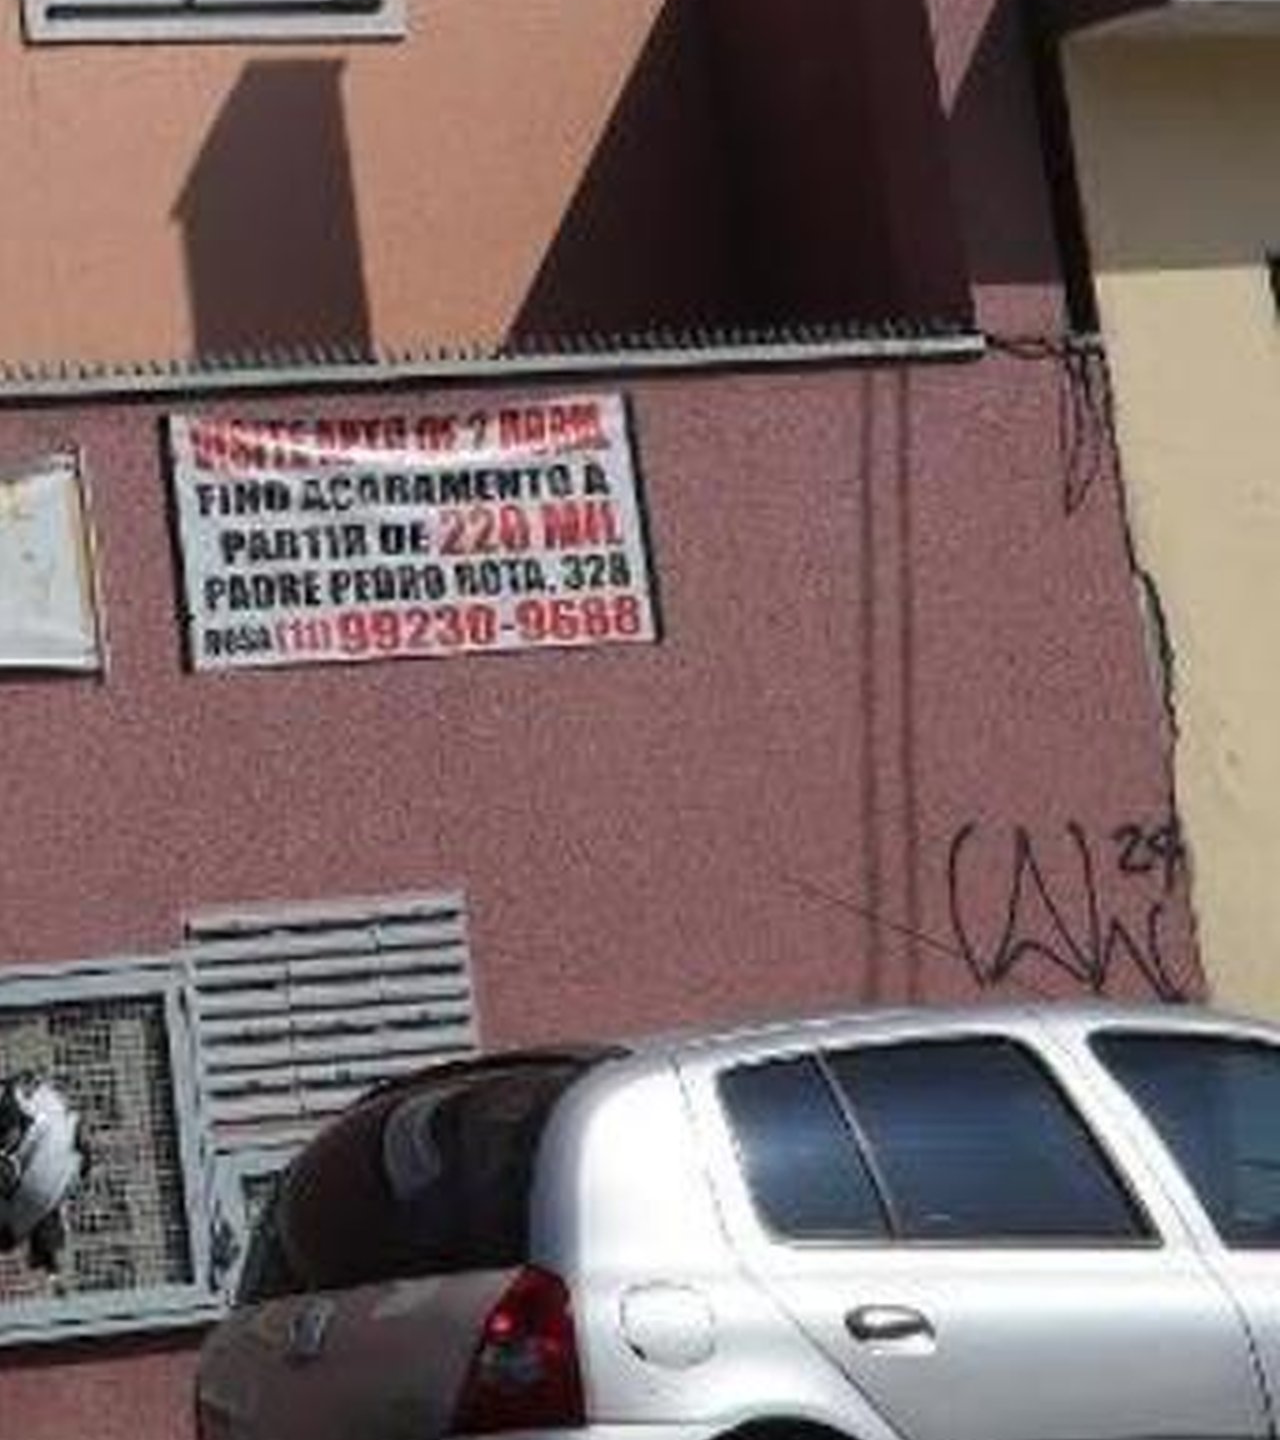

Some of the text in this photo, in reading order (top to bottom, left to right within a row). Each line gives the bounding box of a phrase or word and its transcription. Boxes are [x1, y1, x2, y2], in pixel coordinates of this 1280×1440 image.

[196, 478, 290, 516] FINO
[584, 461, 611, 496] A
[220, 524, 368, 564] PARTIR
[380, 519, 430, 556] DE
[440, 504, 530, 556] 220
[204, 571, 322, 612] PADRE
[329, 562, 446, 607] PEDRO
[561, 551, 633, 590] 328
